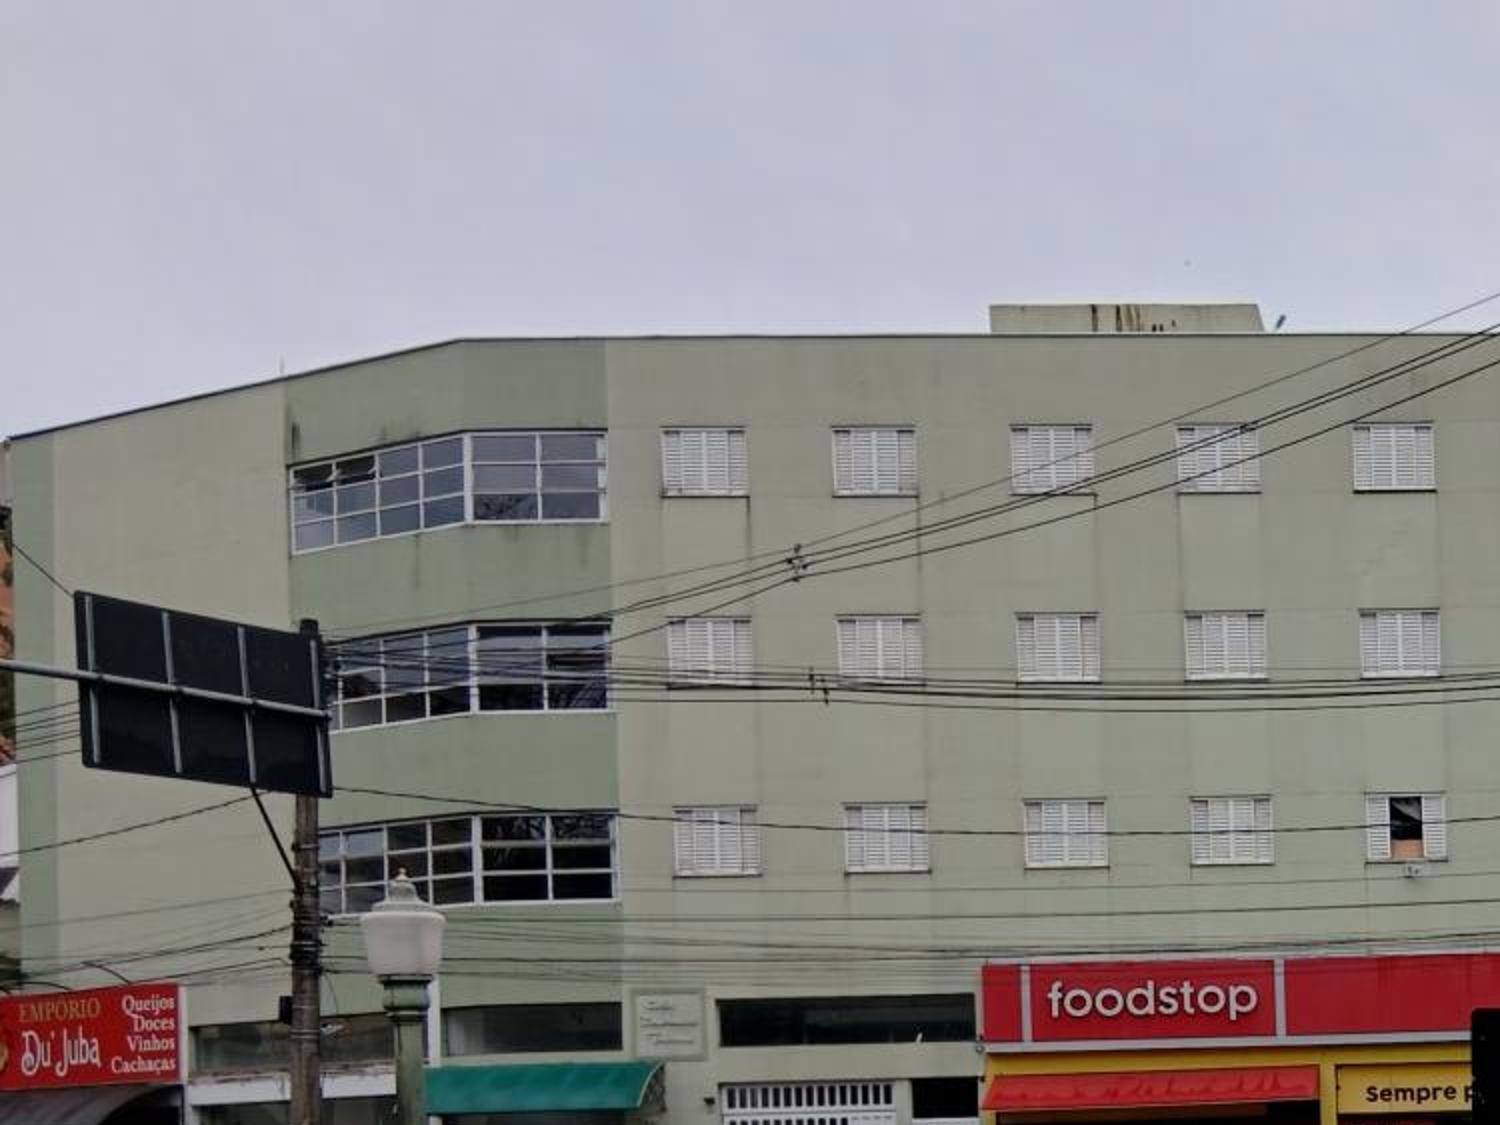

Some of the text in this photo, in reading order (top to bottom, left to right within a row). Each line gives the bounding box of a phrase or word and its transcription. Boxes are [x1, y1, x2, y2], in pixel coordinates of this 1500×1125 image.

[121, 995, 175, 1016] Queijos
[1047, 979, 1257, 1020] foodstop
[133, 1015, 175, 1032] Doces
[127, 1034, 175, 1052] Vinhos
[111, 1055, 176, 1075] Cachaças
[1365, 1085, 1457, 1105] Sempre
